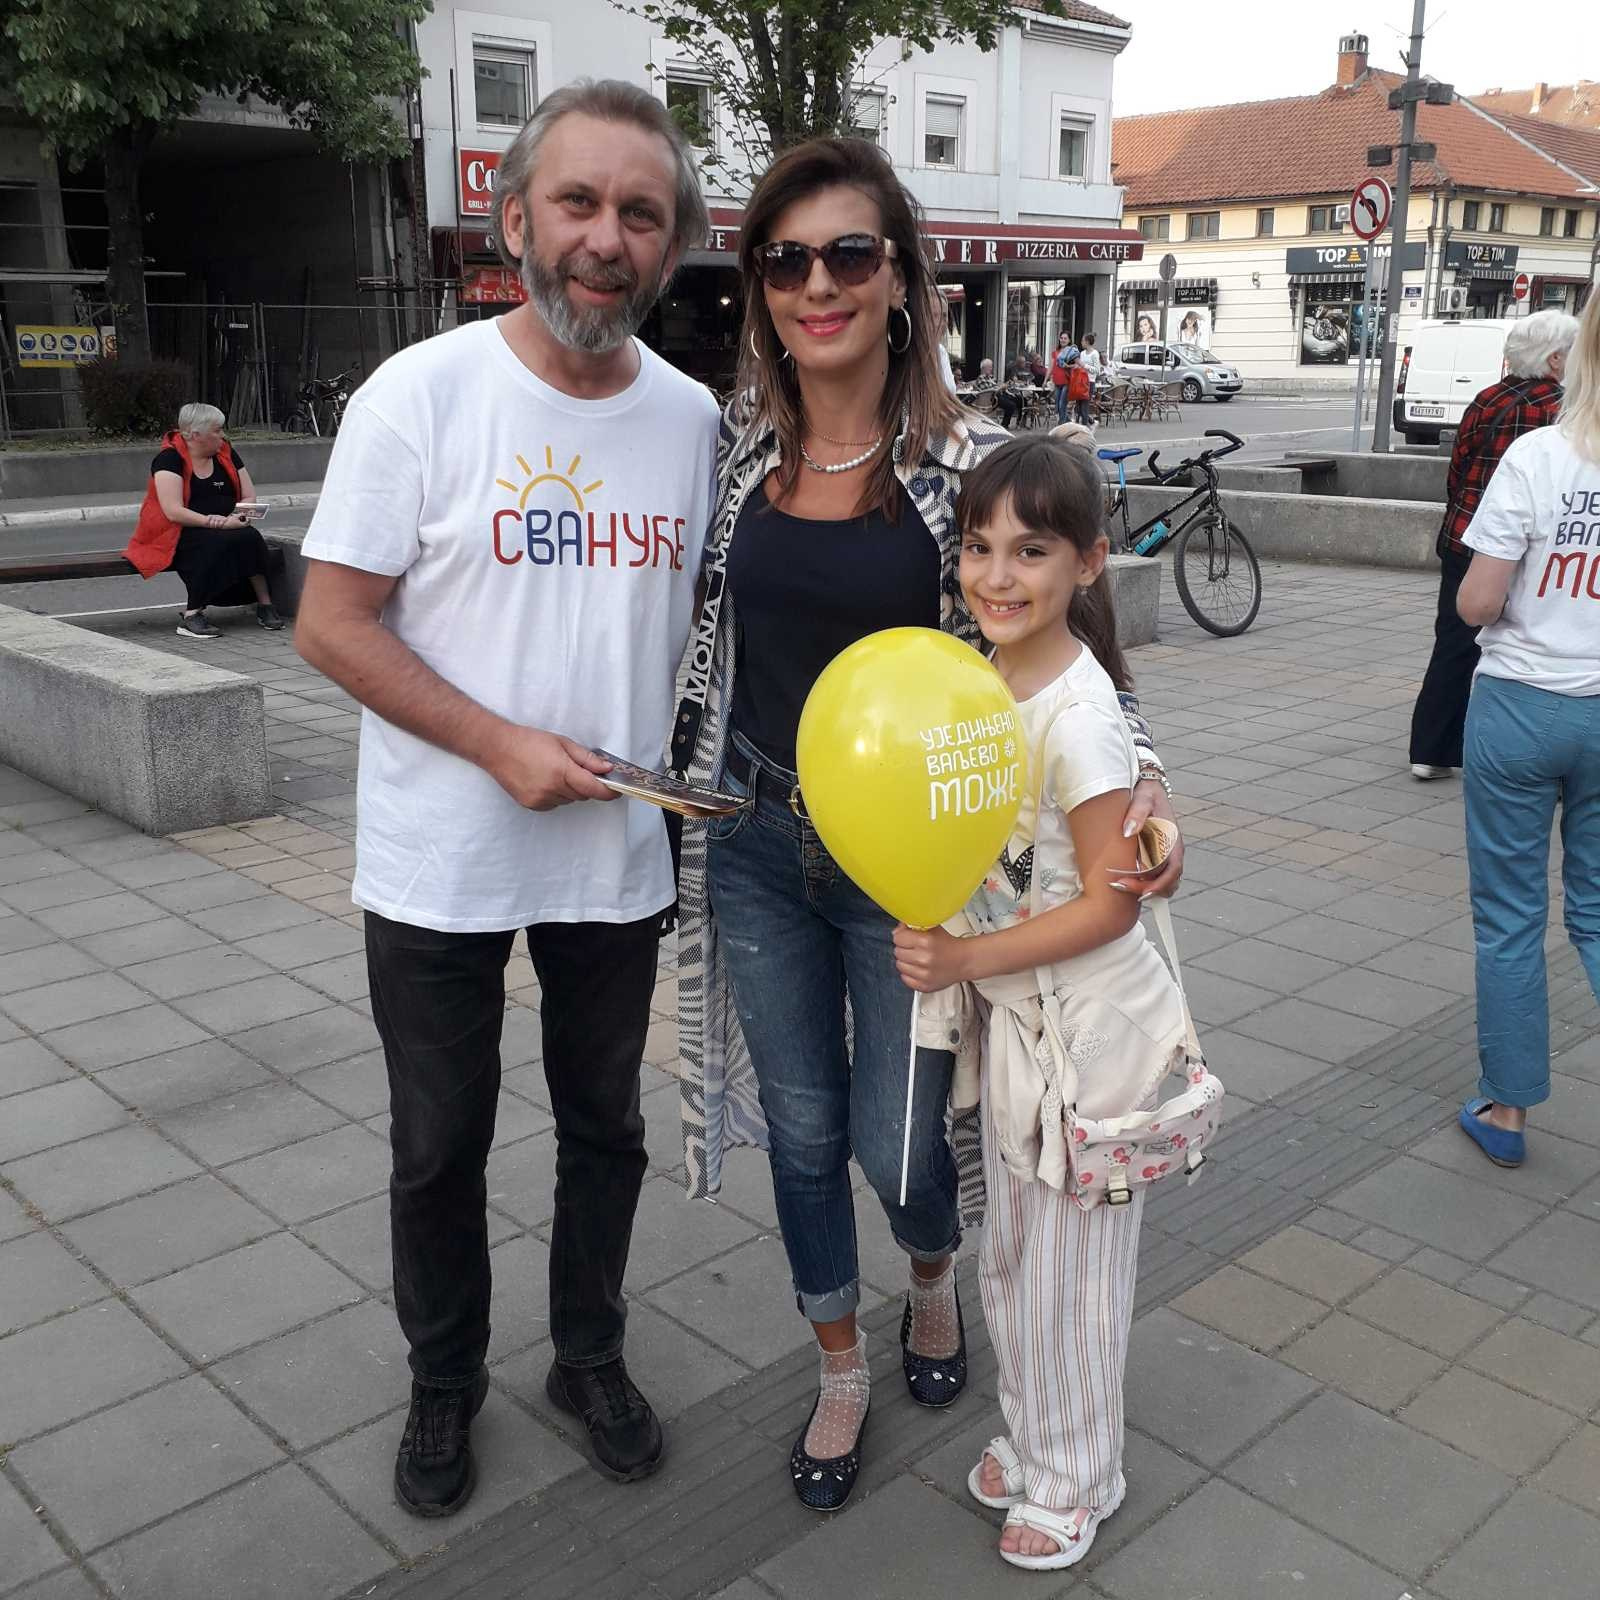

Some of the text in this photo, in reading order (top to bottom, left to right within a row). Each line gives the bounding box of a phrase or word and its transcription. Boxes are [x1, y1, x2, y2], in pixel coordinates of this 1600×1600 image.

[1016, 242, 1079, 259] PIZZERIA
[1089, 244, 1130, 260] CAFFE
[1316, 247, 1347, 263] TOP
[1467, 245, 1506, 262] TOP TIM
[713, 461, 752, 573] MONA
[493, 509, 686, 571] СВАНУЋЕ
[683, 596, 721, 704] MONA
[919, 710, 1015, 751] УЈЕДИЊЕНО
[926, 742, 999, 776] ВАЉЕВО
[930, 762, 1020, 821] МОЖЕ
